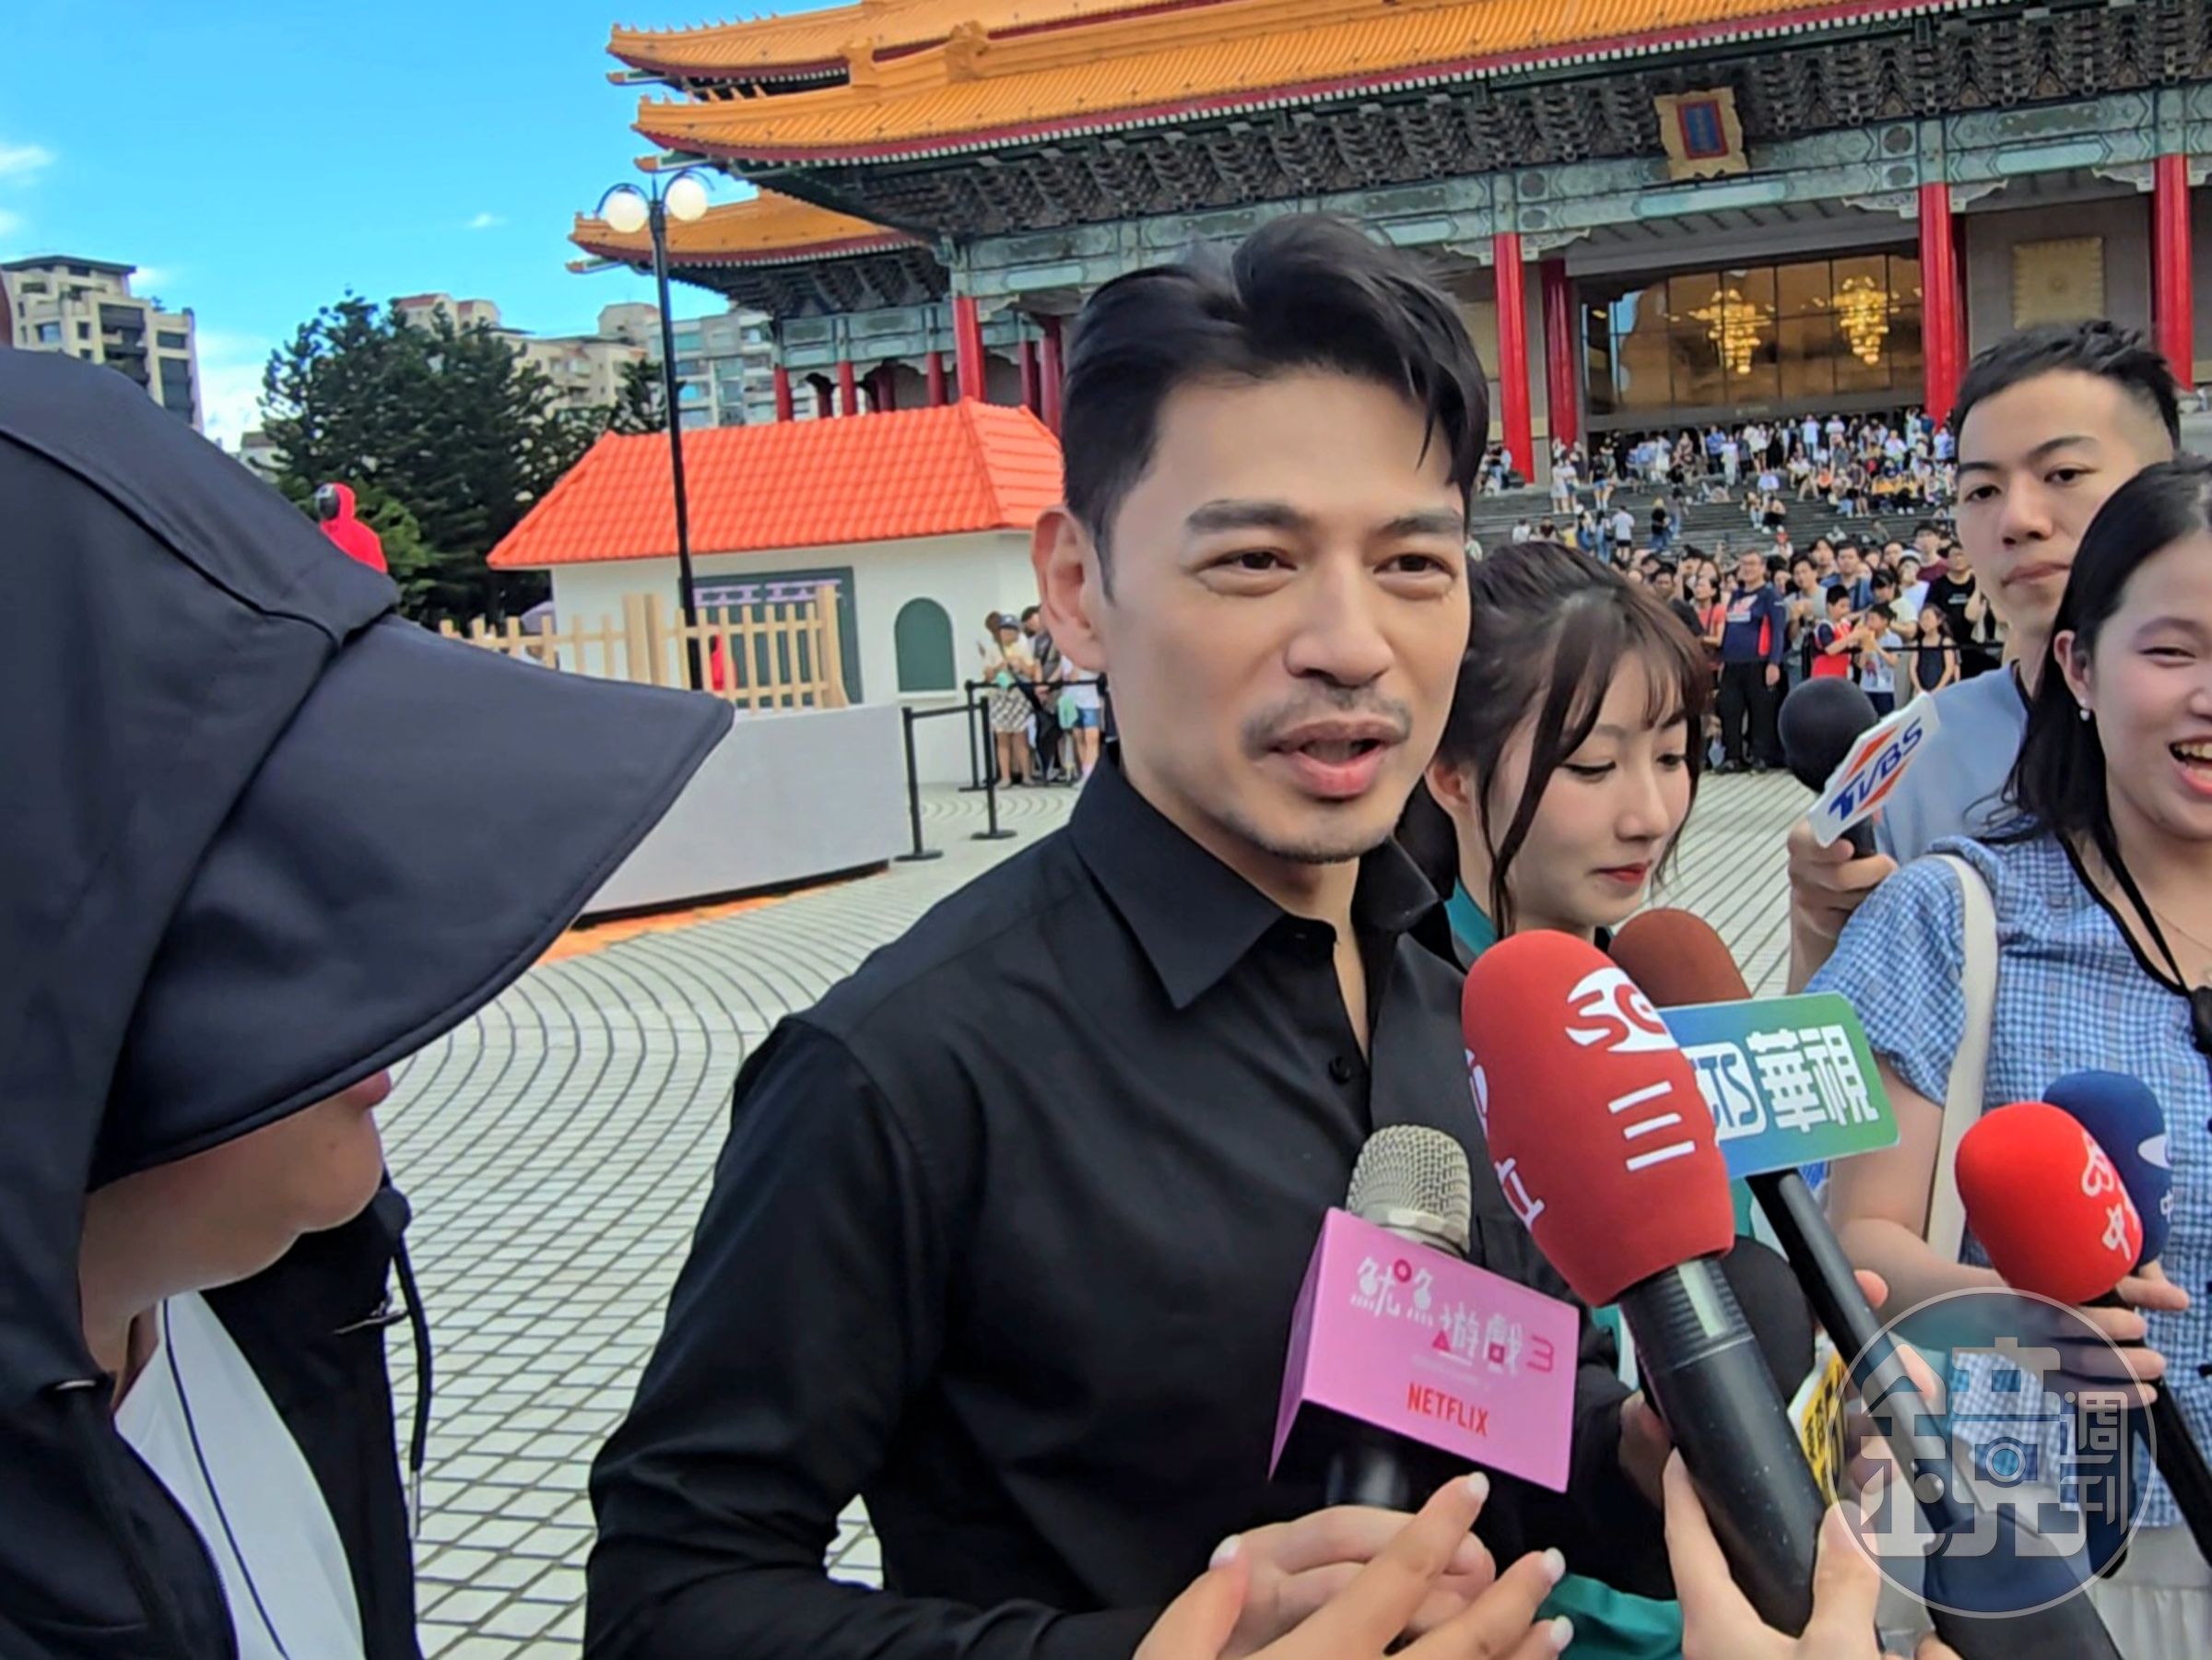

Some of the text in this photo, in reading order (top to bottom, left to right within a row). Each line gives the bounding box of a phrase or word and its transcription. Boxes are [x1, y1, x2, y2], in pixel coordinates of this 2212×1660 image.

[1828, 716, 1924, 820] TVBS
[1746, 1025, 1880, 1134] 華視
[1406, 1382, 1489, 1438] NETFLIX
